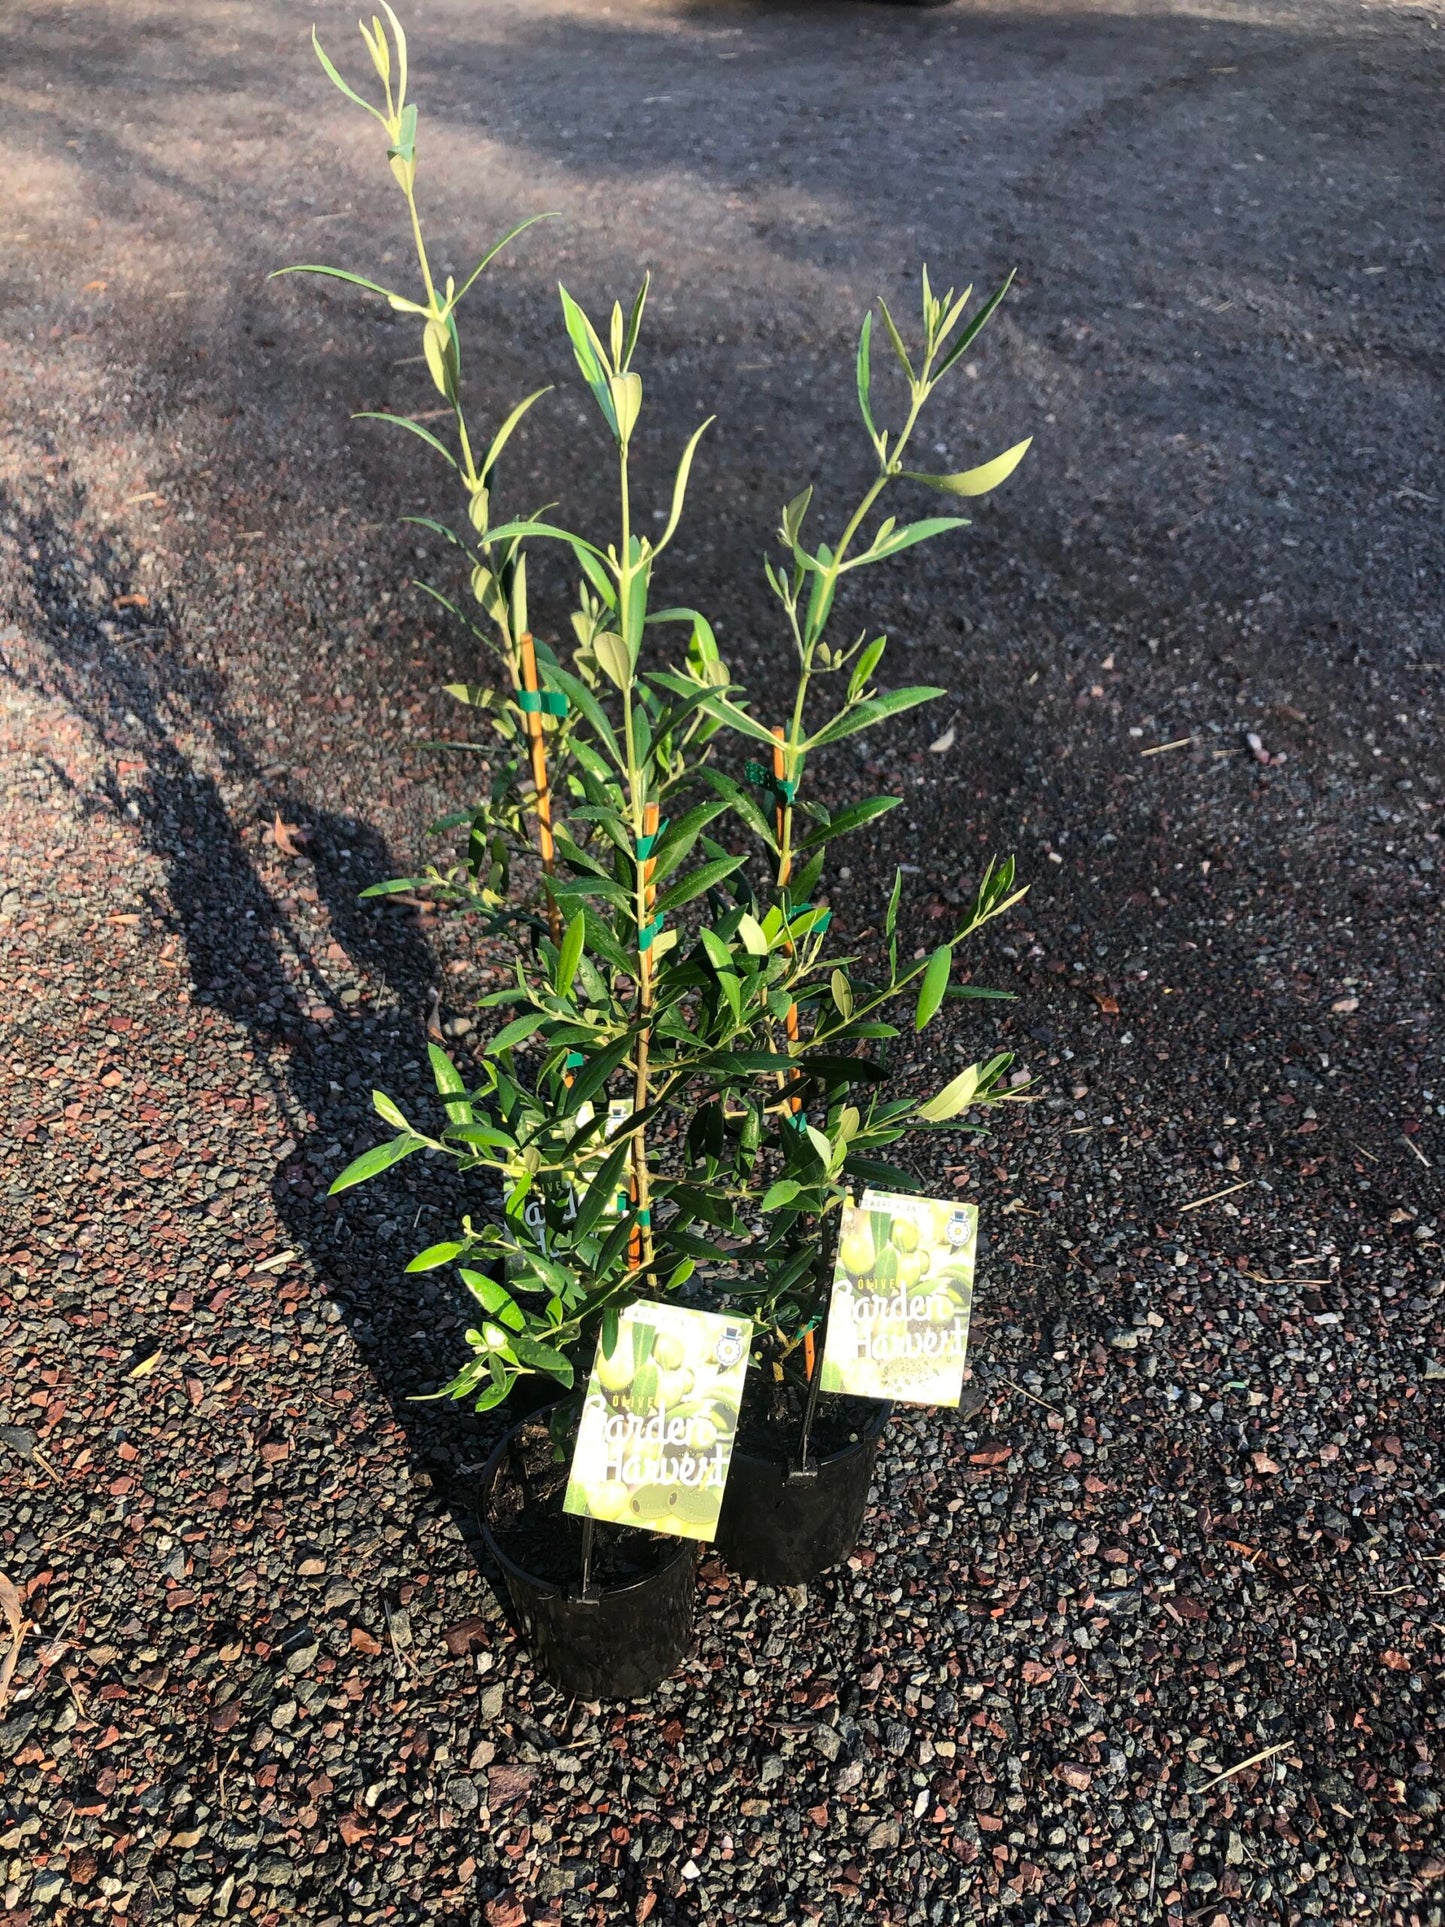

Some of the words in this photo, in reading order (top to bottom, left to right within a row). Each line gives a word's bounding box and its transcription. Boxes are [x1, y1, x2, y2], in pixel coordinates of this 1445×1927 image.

[858, 1277, 896, 1290] OLIVE
[850, 1317, 968, 1360] Harvest
[612, 1395, 655, 1409] OLIVE
[596, 1444, 730, 1487] Harvest
